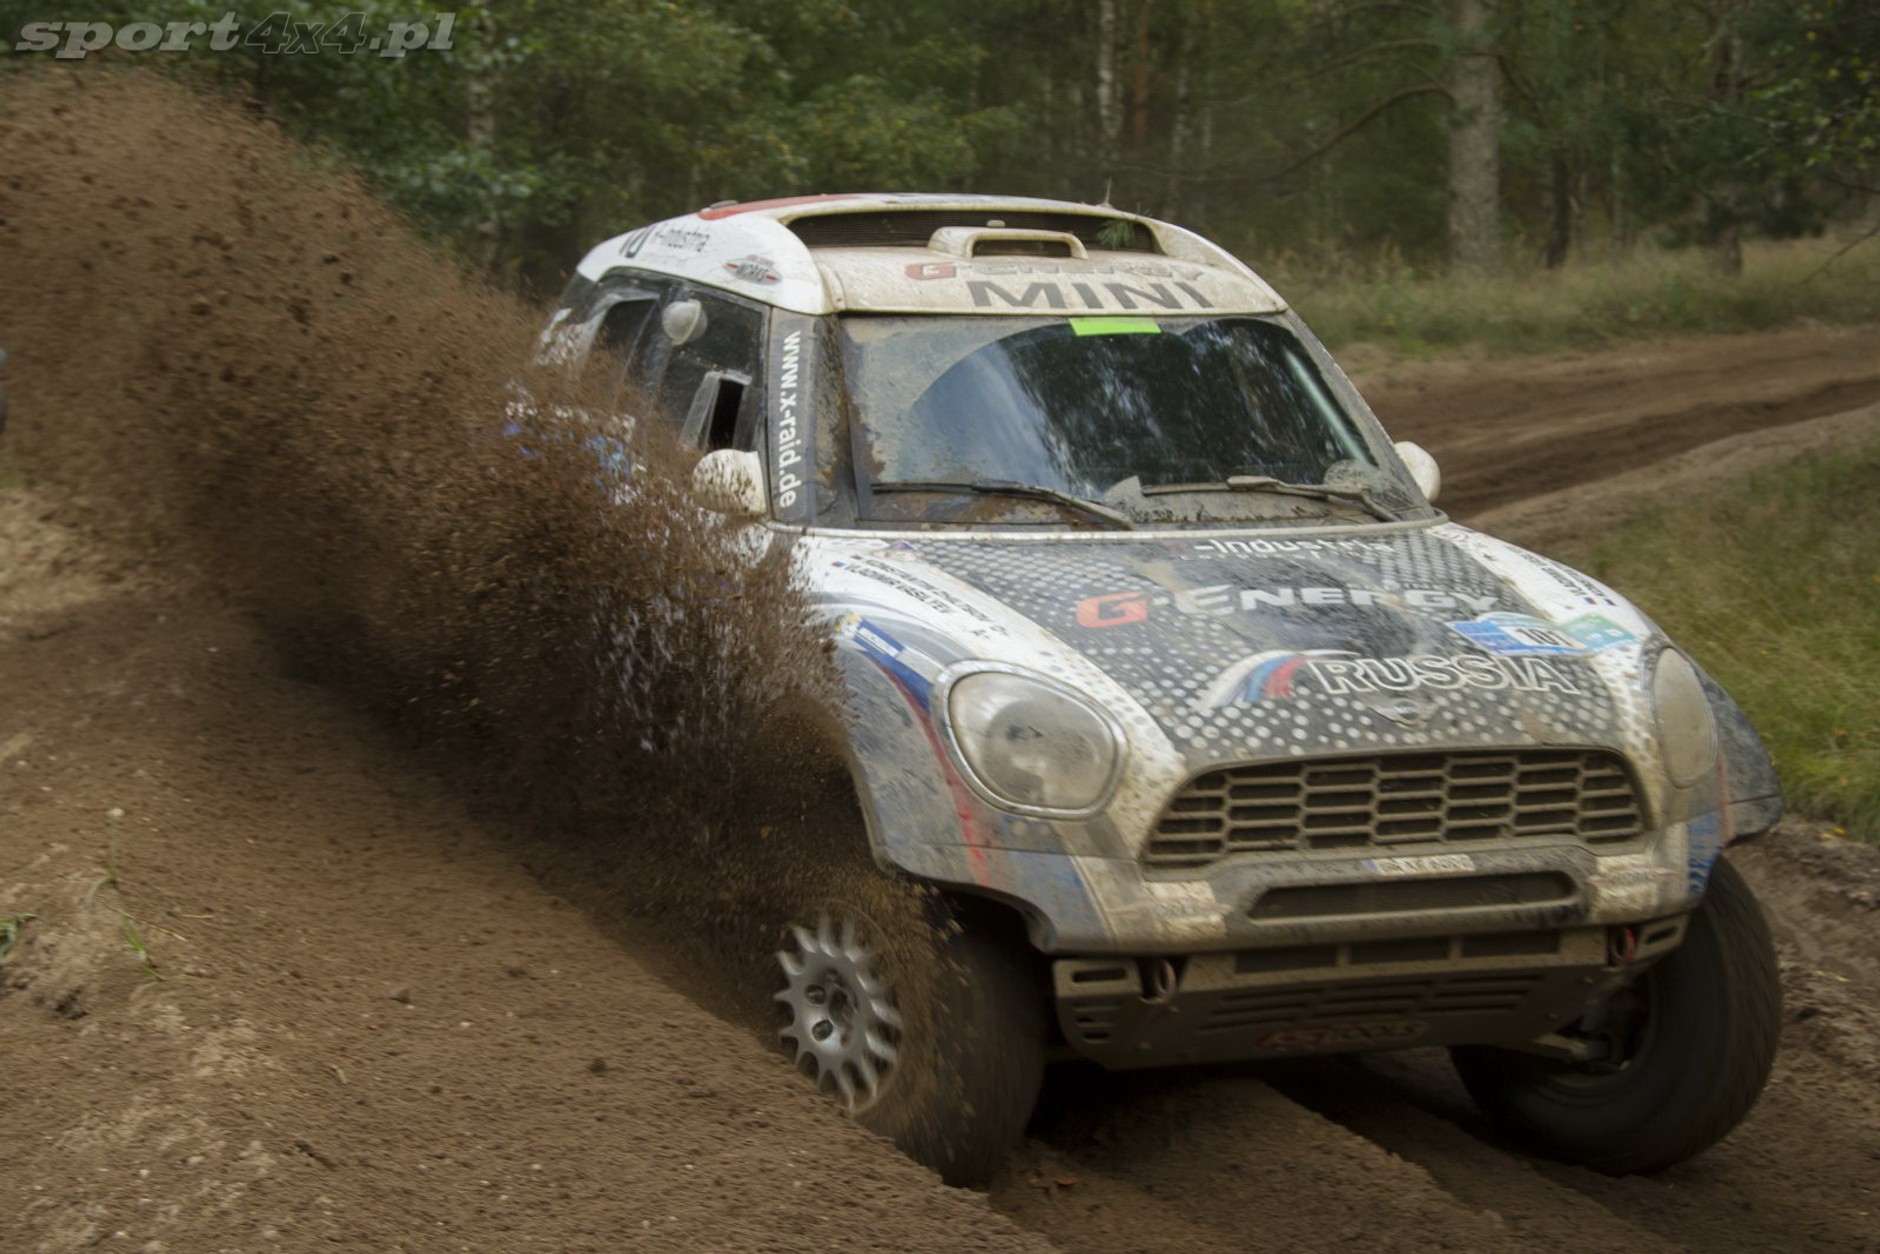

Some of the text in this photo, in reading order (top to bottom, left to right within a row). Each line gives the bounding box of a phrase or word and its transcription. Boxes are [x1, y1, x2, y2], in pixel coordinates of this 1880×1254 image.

[966, 280, 1214, 310] MINI
[778, 331, 802, 509] www.x-raid.de
[1075, 584, 1498, 629] G-ENERGY
[1306, 652, 1582, 696] RUSSIA
